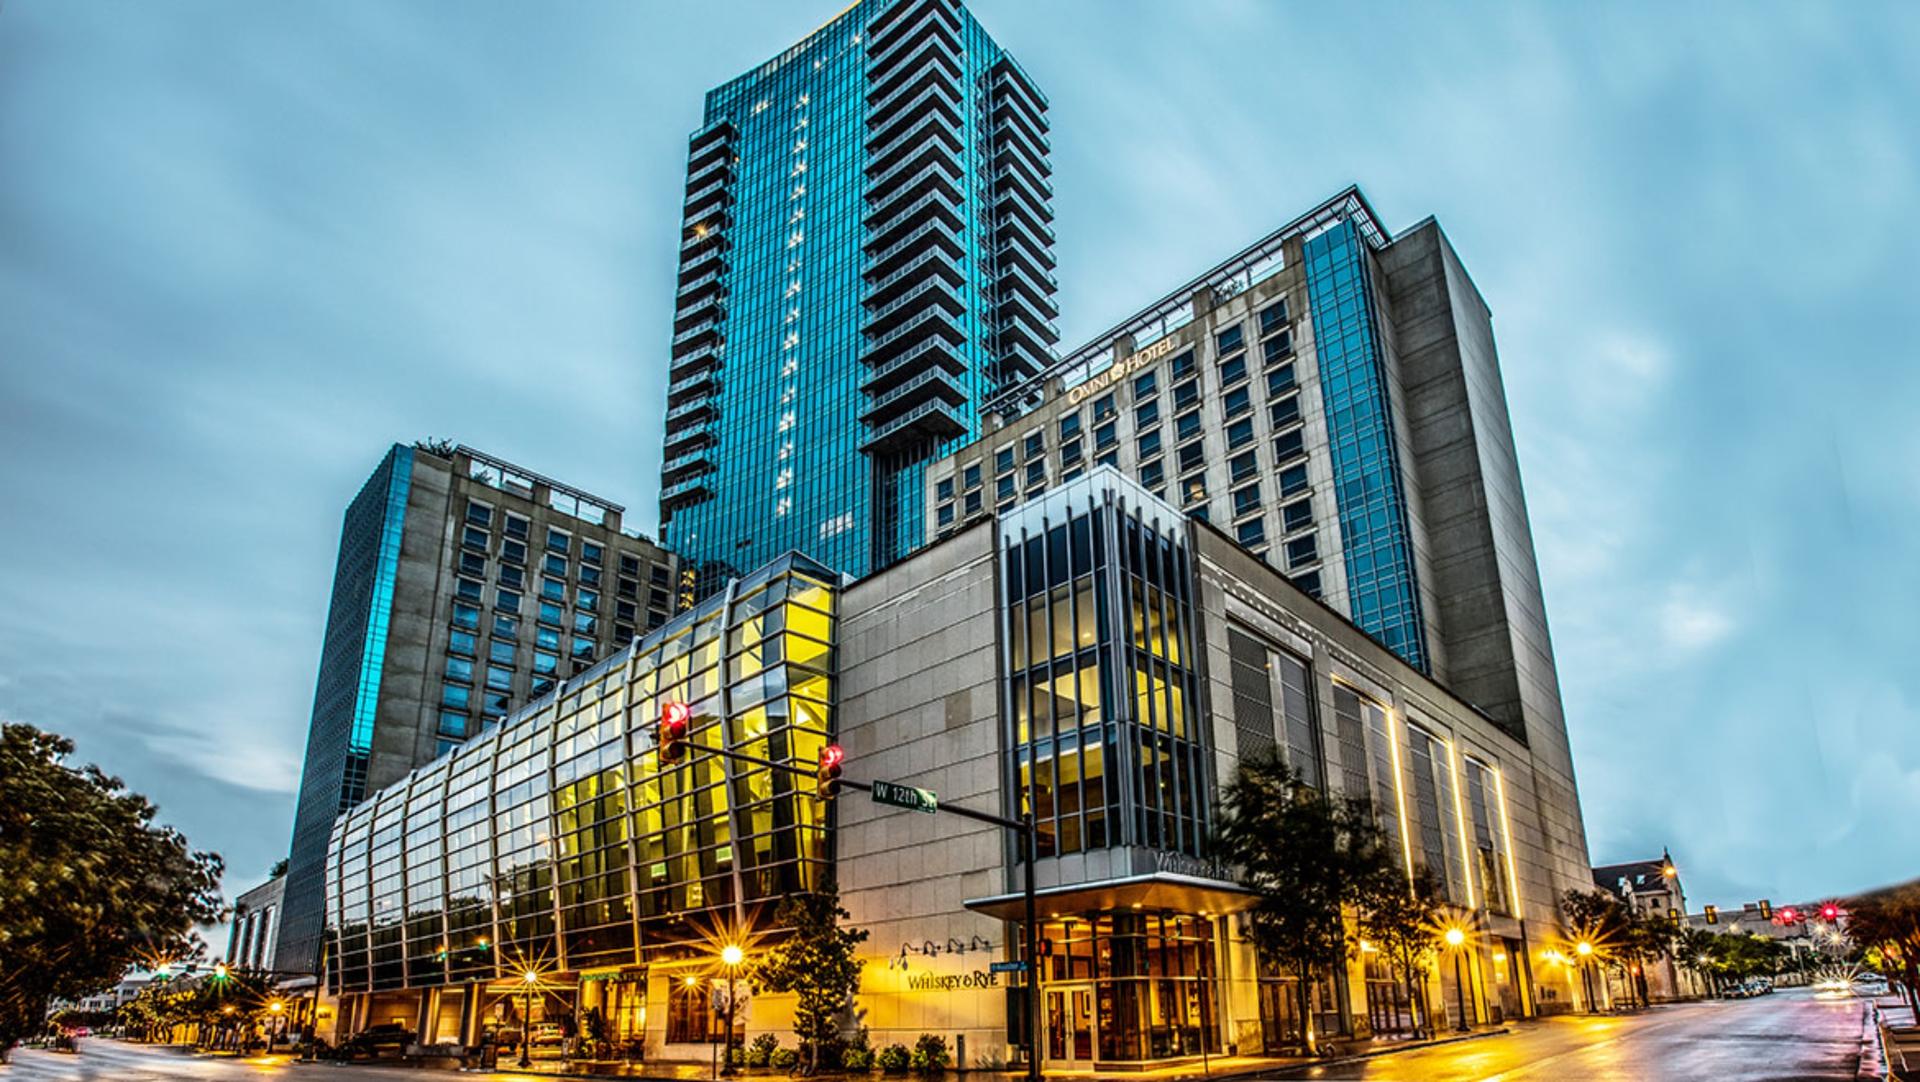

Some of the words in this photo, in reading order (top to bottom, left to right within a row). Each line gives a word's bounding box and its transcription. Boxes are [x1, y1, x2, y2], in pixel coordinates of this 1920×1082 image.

[1068, 371, 1109, 405] OMNI
[1125, 337, 1176, 373] HOTEL
[875, 783, 888, 799] W
[893, 787, 917, 806] 12th
[908, 971, 962, 991] WHISKEY
[973, 970, 999, 988] RYE
